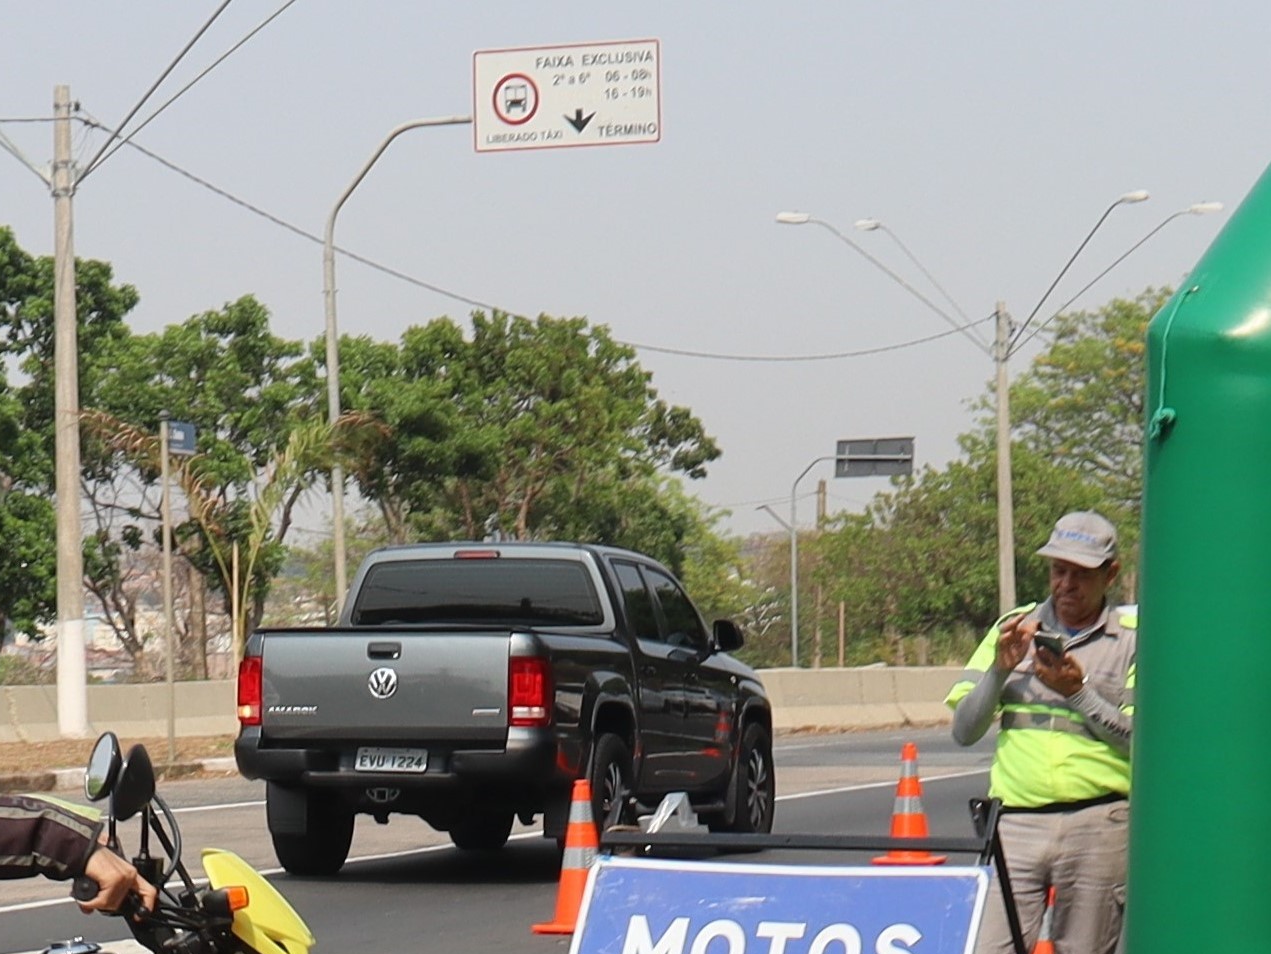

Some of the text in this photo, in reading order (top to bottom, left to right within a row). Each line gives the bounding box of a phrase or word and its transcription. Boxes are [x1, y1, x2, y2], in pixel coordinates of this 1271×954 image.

[535, 50, 654, 69] FAIXA EXCLUSIVA
[605, 70, 620, 82] 06
[631, 69, 652, 81] 08h
[604, 87, 619, 100] 16
[630, 86, 652, 98] 19h
[485, 131, 538, 144] LIBERADO
[390, 756, 424, 769] 1224
